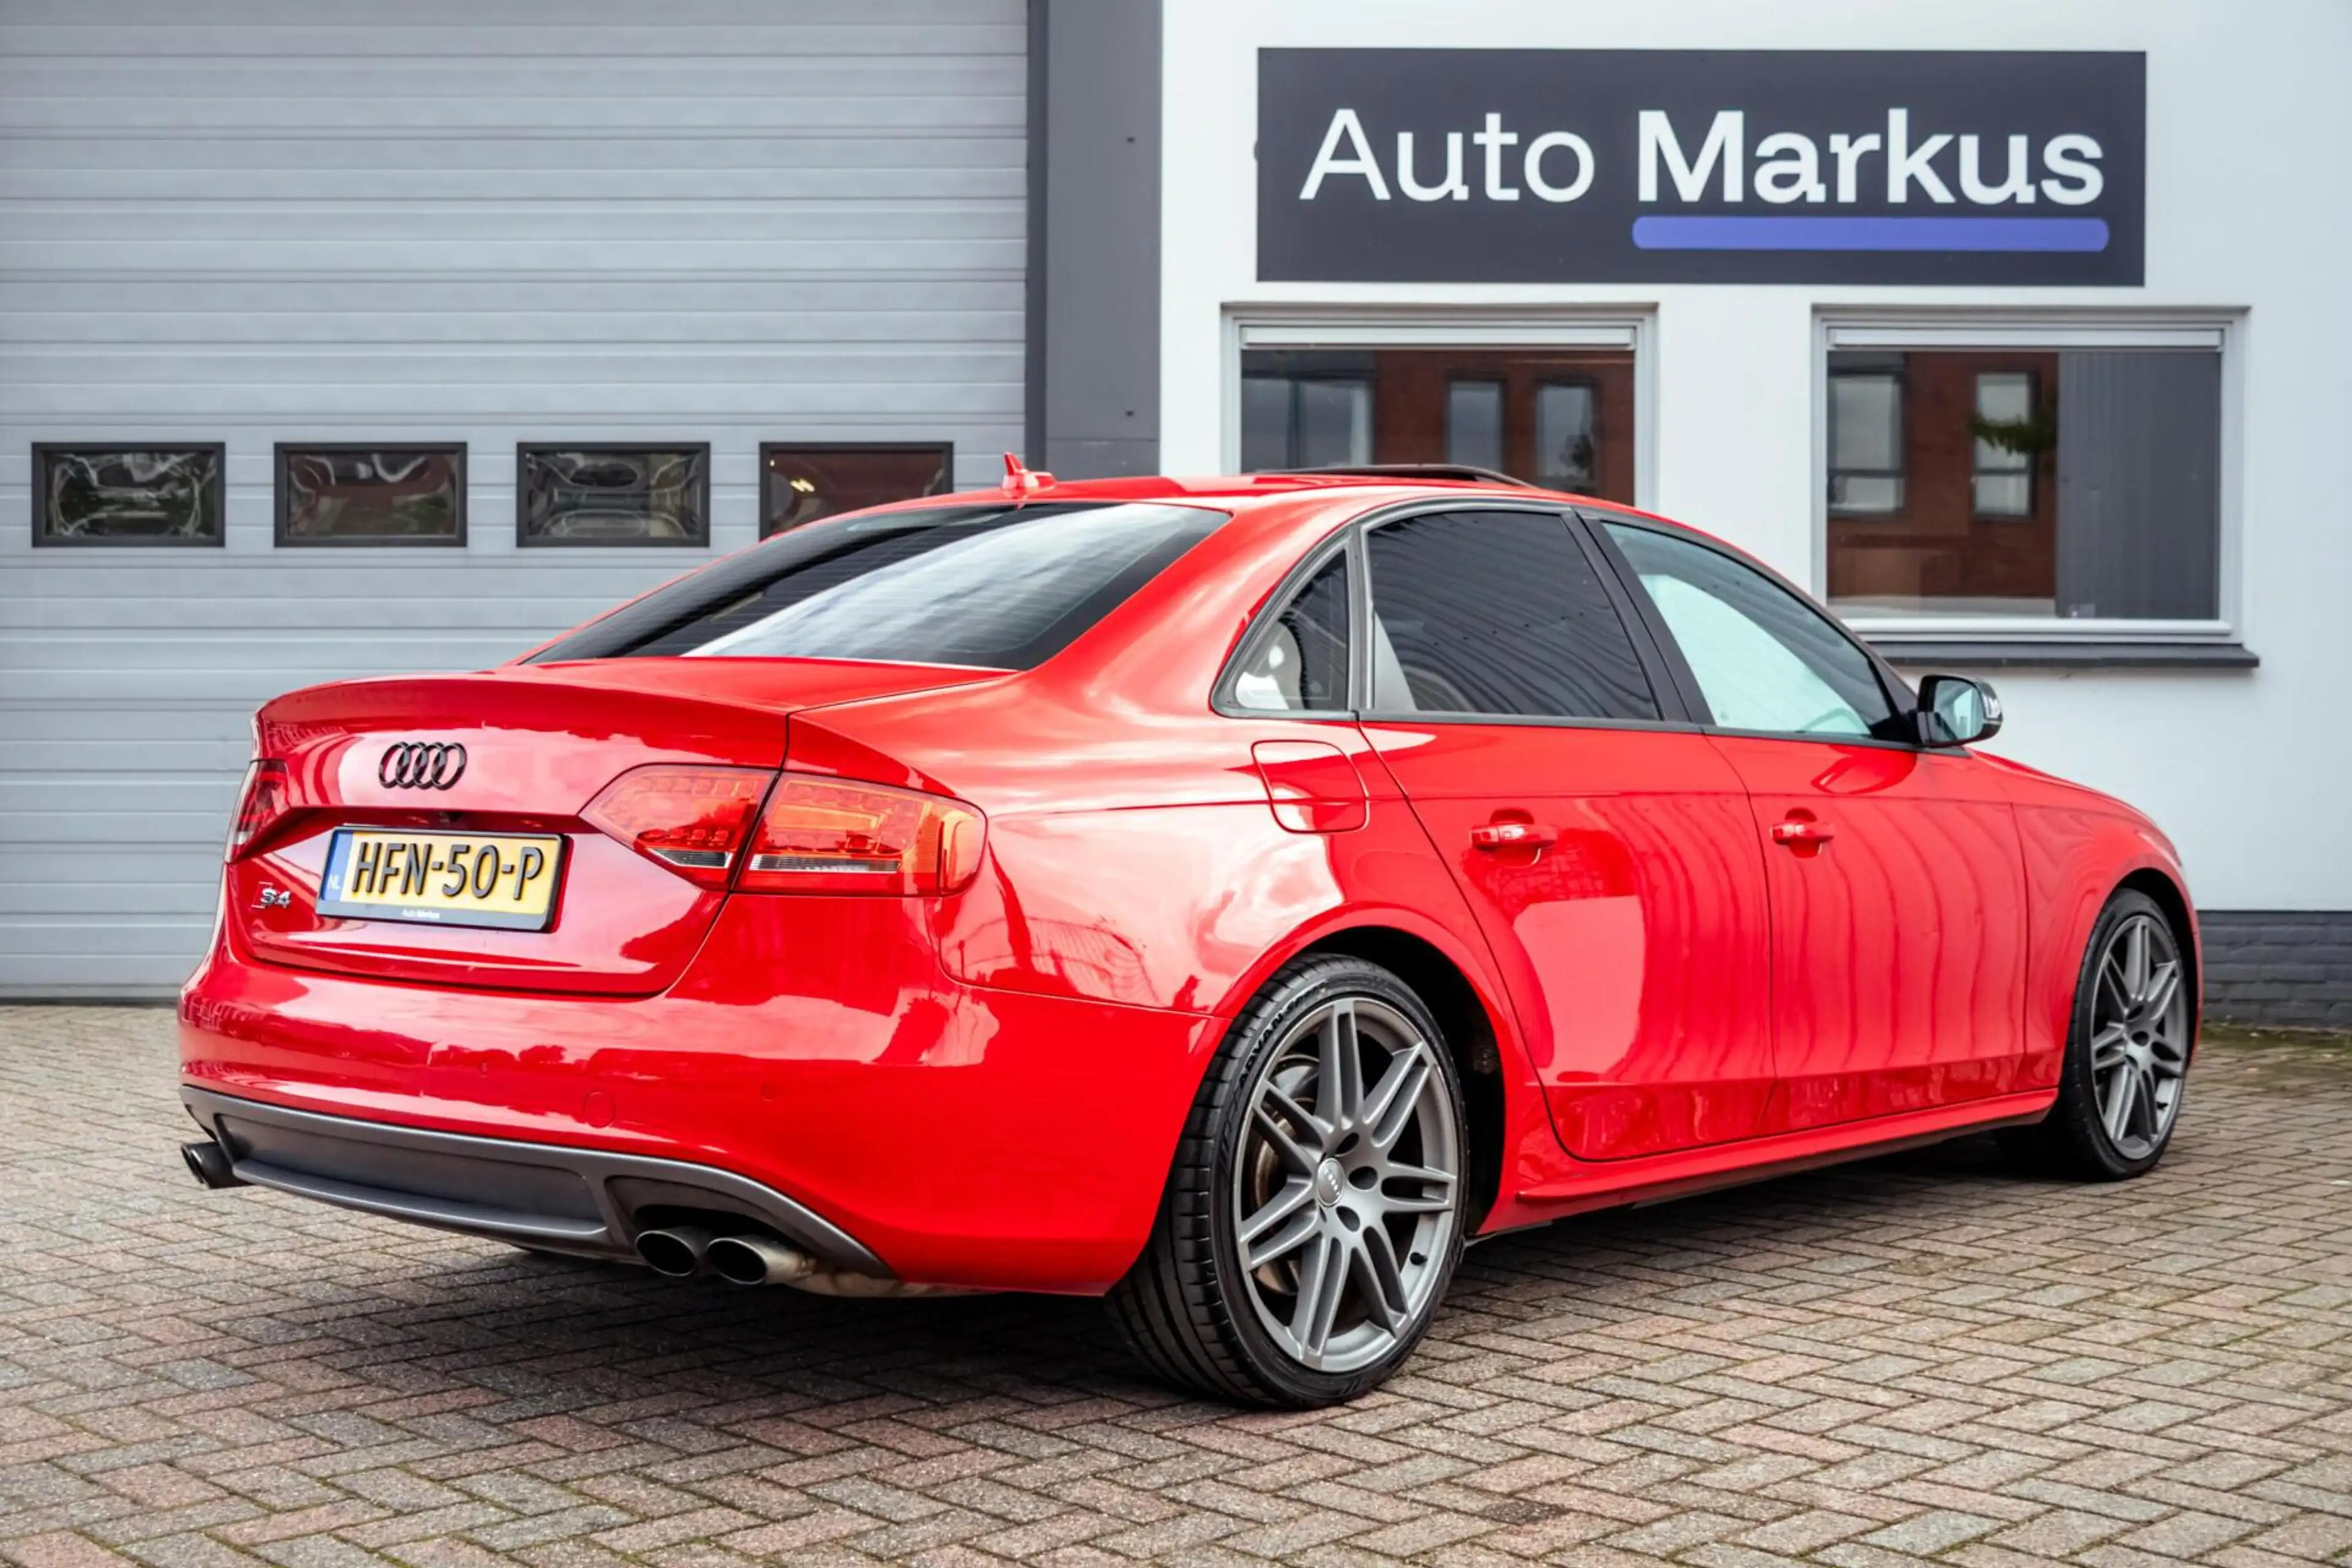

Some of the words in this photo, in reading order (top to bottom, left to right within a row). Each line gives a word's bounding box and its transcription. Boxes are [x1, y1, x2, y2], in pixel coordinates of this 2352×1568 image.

[1300, 108, 1594, 202] Auto
[1638, 108, 2103, 204] Markus
[260, 888, 291, 908] S4
[352, 842, 544, 900] HFN-50-P
[1238, 1012, 1284, 1089] ADVAN
